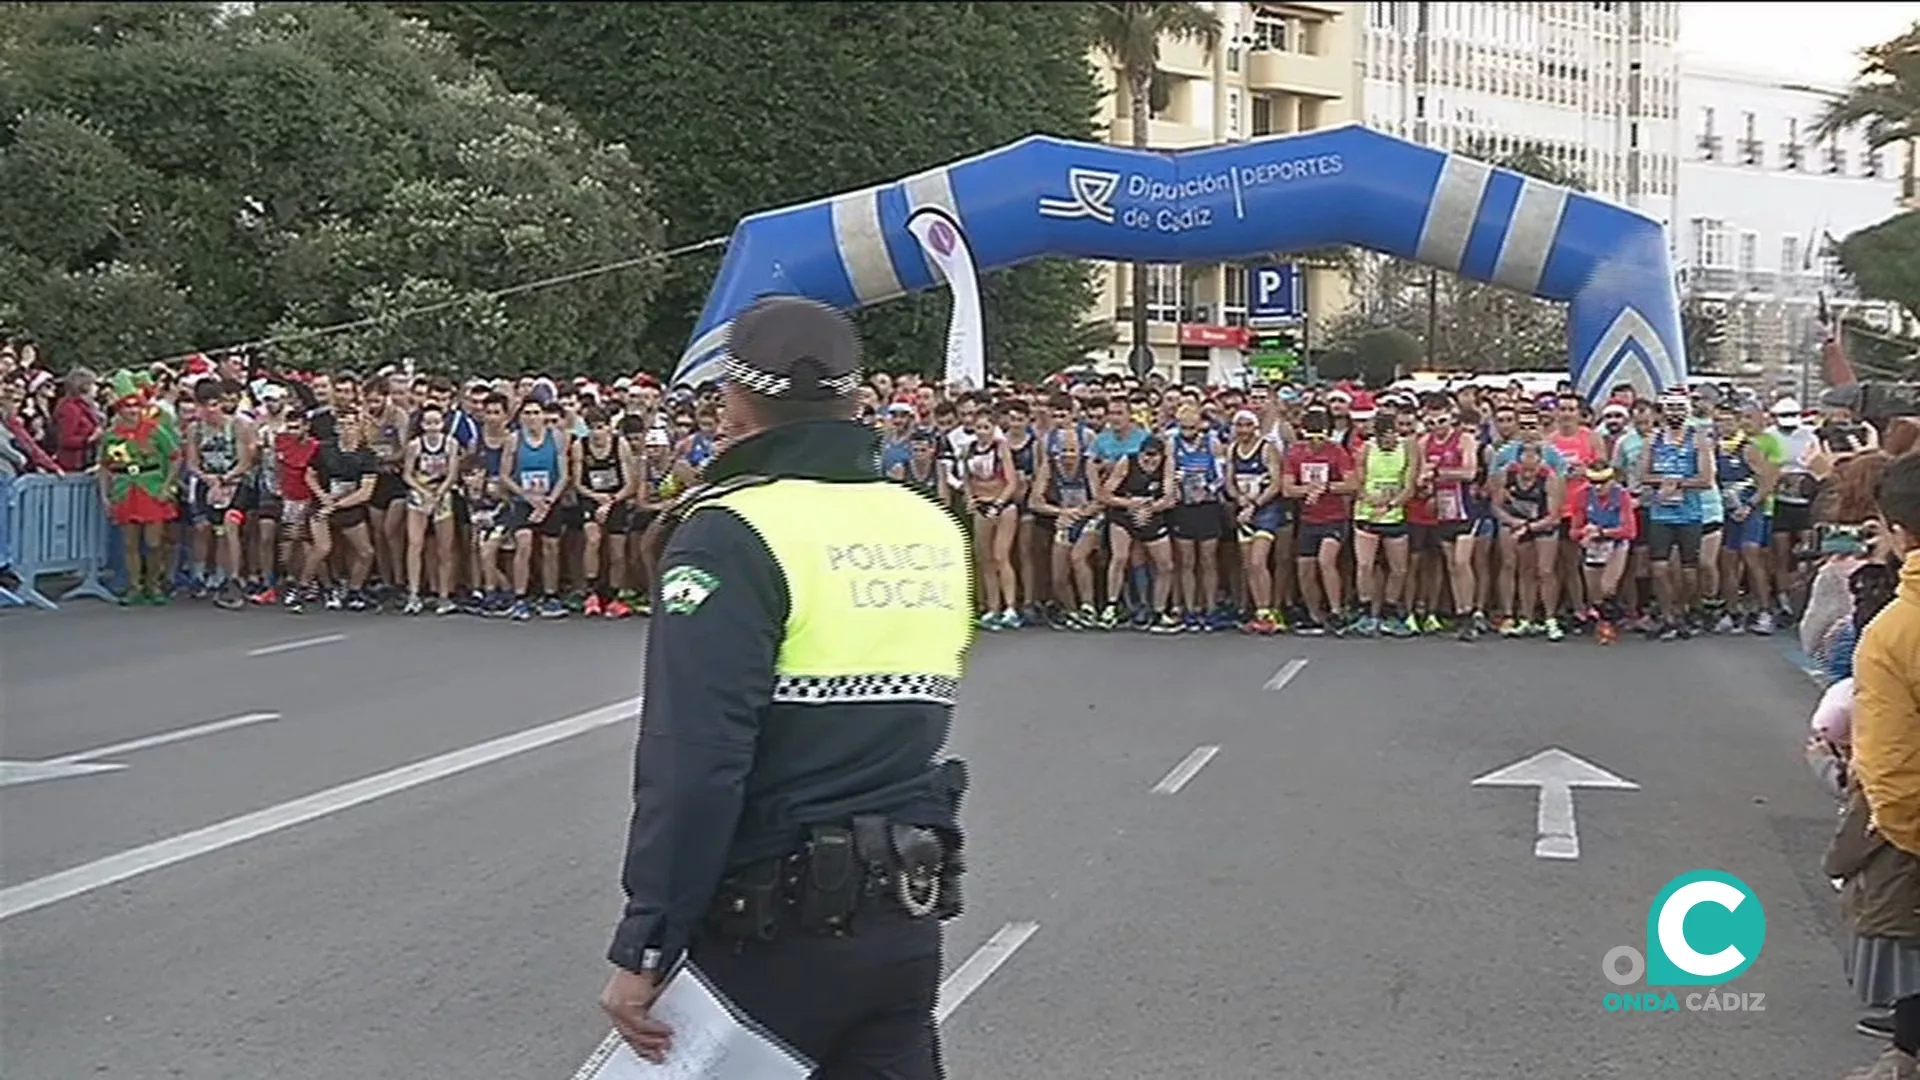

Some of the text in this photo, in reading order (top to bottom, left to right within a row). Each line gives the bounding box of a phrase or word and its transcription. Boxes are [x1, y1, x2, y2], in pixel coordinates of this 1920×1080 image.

[1242, 154, 1344, 186] DEPORTES
[1128, 172, 1231, 202] Dipución
[1123, 206, 1151, 229] de
[1258, 270, 1281, 304] P
[850, 578, 954, 610] LOCAL
